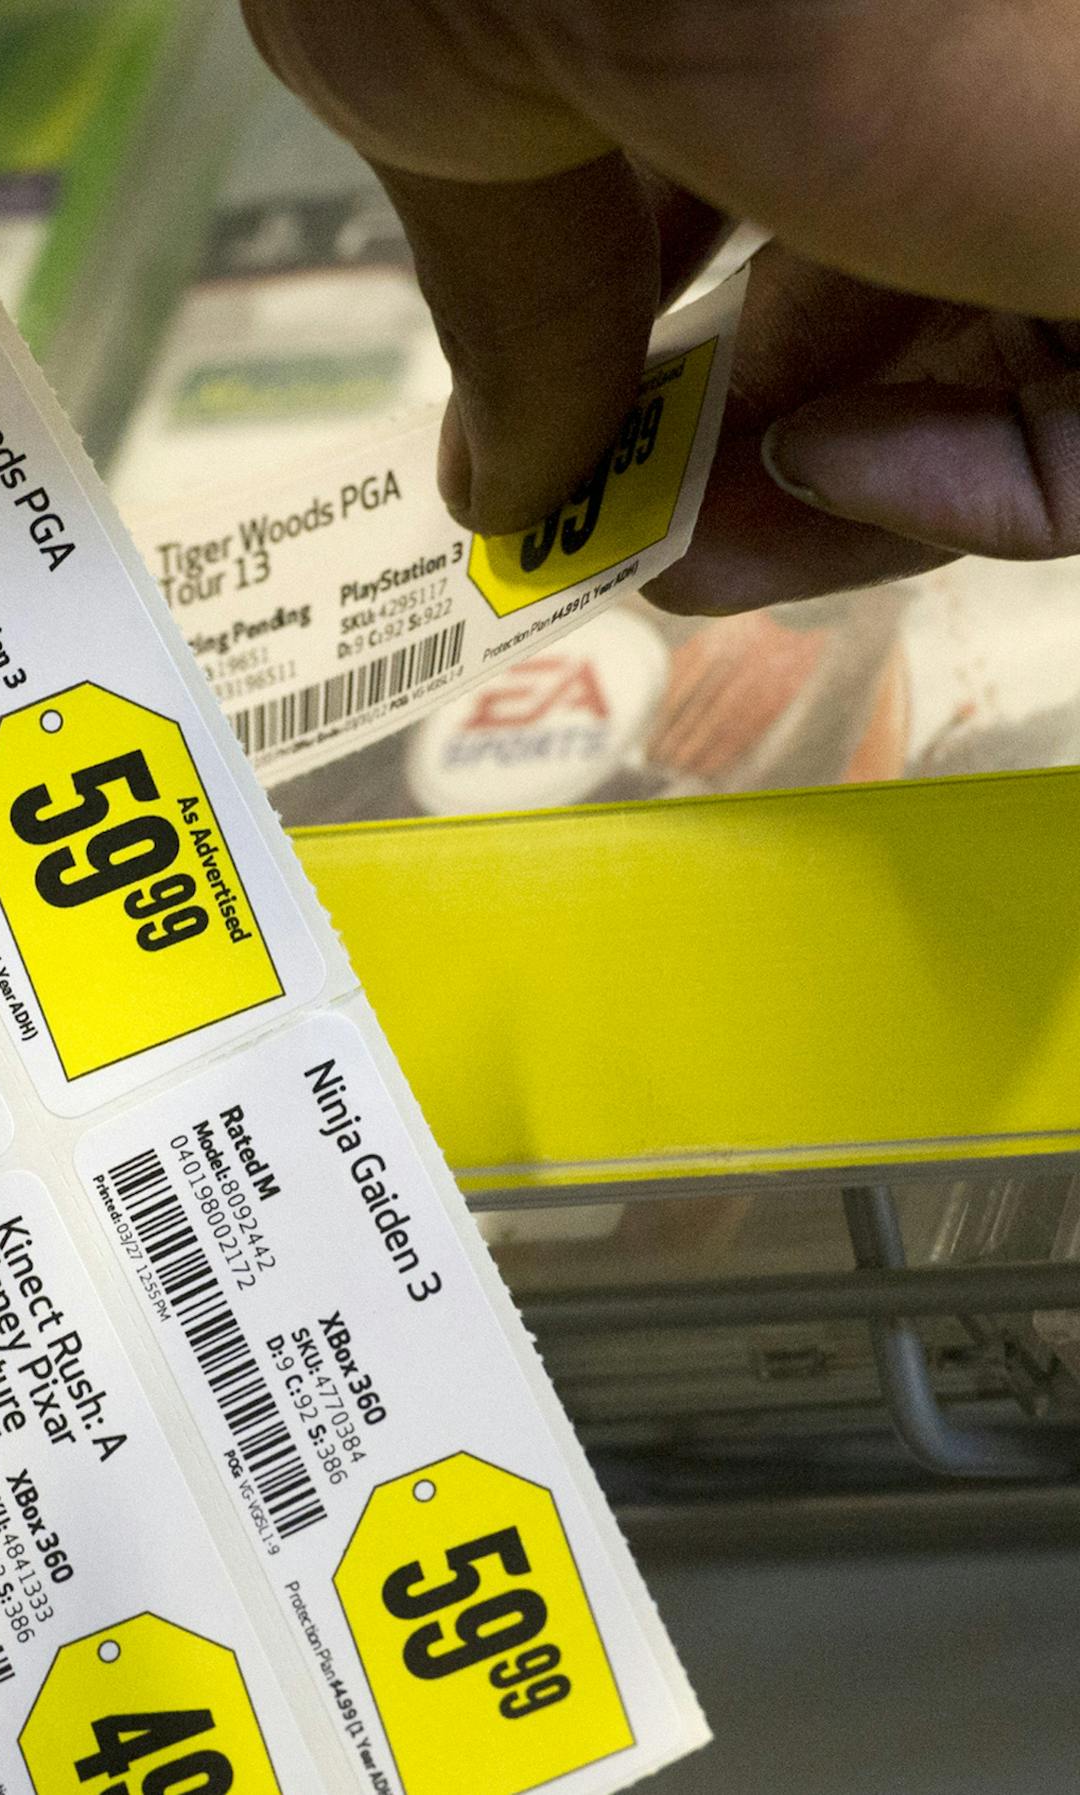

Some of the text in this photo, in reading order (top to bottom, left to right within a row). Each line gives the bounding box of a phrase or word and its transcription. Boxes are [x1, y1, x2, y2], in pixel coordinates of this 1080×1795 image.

[14, 487, 75, 572] PGA
[155, 470, 401, 579] Tiger Woods PGA
[160, 550, 271, 608] Tour 13
[340, 541, 464, 607] PlayStation 3
[233, 603, 311, 645] Pending
[3, 668, 26, 688] 3
[177, 797, 252, 943] As Advertised
[9, 1002, 38, 1041] ADH)
[220, 1105, 280, 1201] Rated M
[304, 1059, 441, 1301] Ninja Gaiden 3
[171, 1135, 255, 1290] 040198002172
[154, 1299, 171, 1321] PM
[18, 1355, 76, 1444] Pixar
[47, 1331, 106, 1430] Rush:
[92, 1434, 127, 1462] A
[318, 1311, 386, 1425] XBox 360
[6, 1469, 73, 1583] XBox 360
[285, 1581, 326, 1654] Protection
[316, 1649, 337, 1680] Plan
[330, 1680, 357, 1720] $4.99
[346, 1721, 364, 1738] (1
[357, 1737, 376, 1769] Year
